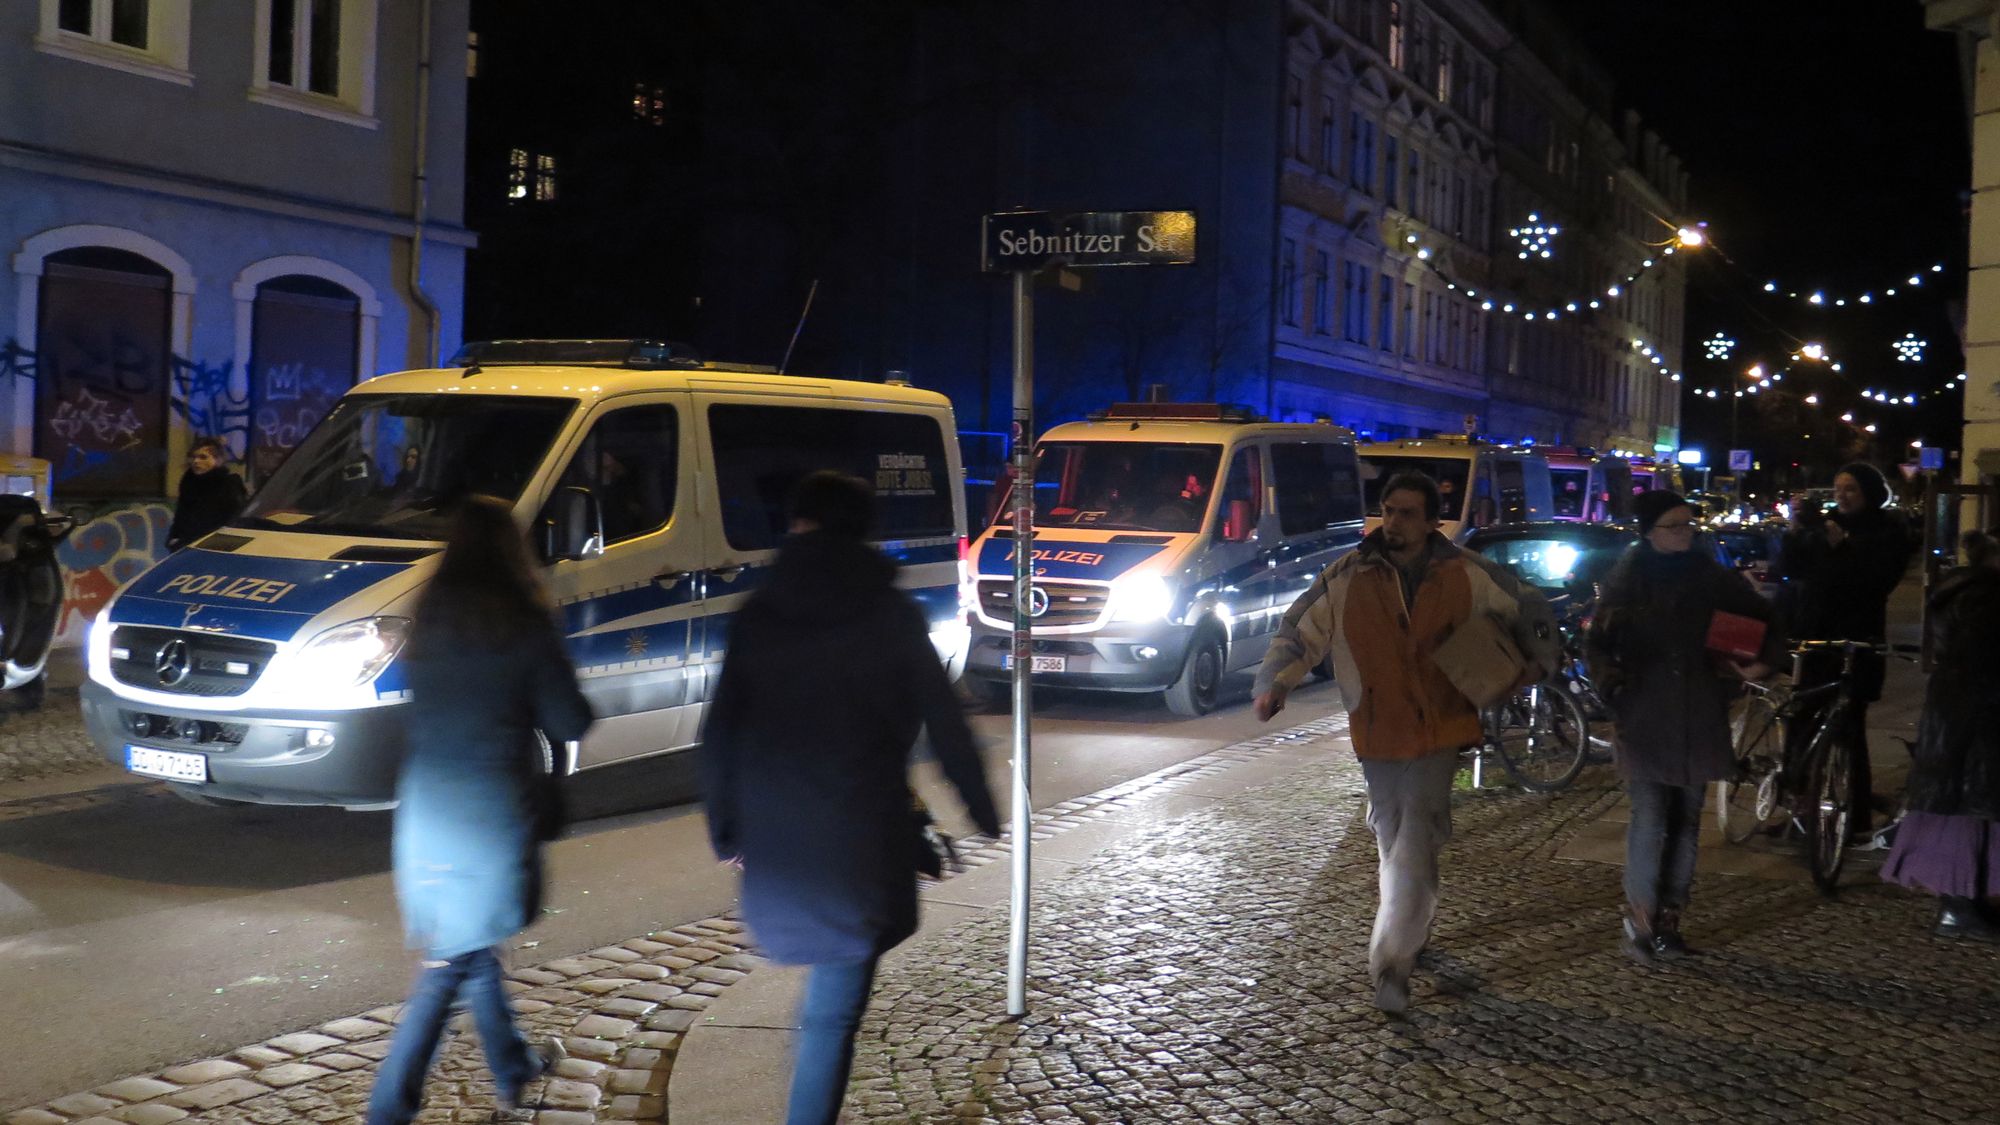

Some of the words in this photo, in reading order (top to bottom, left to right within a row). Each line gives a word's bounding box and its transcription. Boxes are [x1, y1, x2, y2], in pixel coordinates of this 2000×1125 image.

[998, 227, 1125, 256] Sebnitzer
[156, 574, 298, 604] POLIZEI
[1035, 658, 1063, 671] 7586
